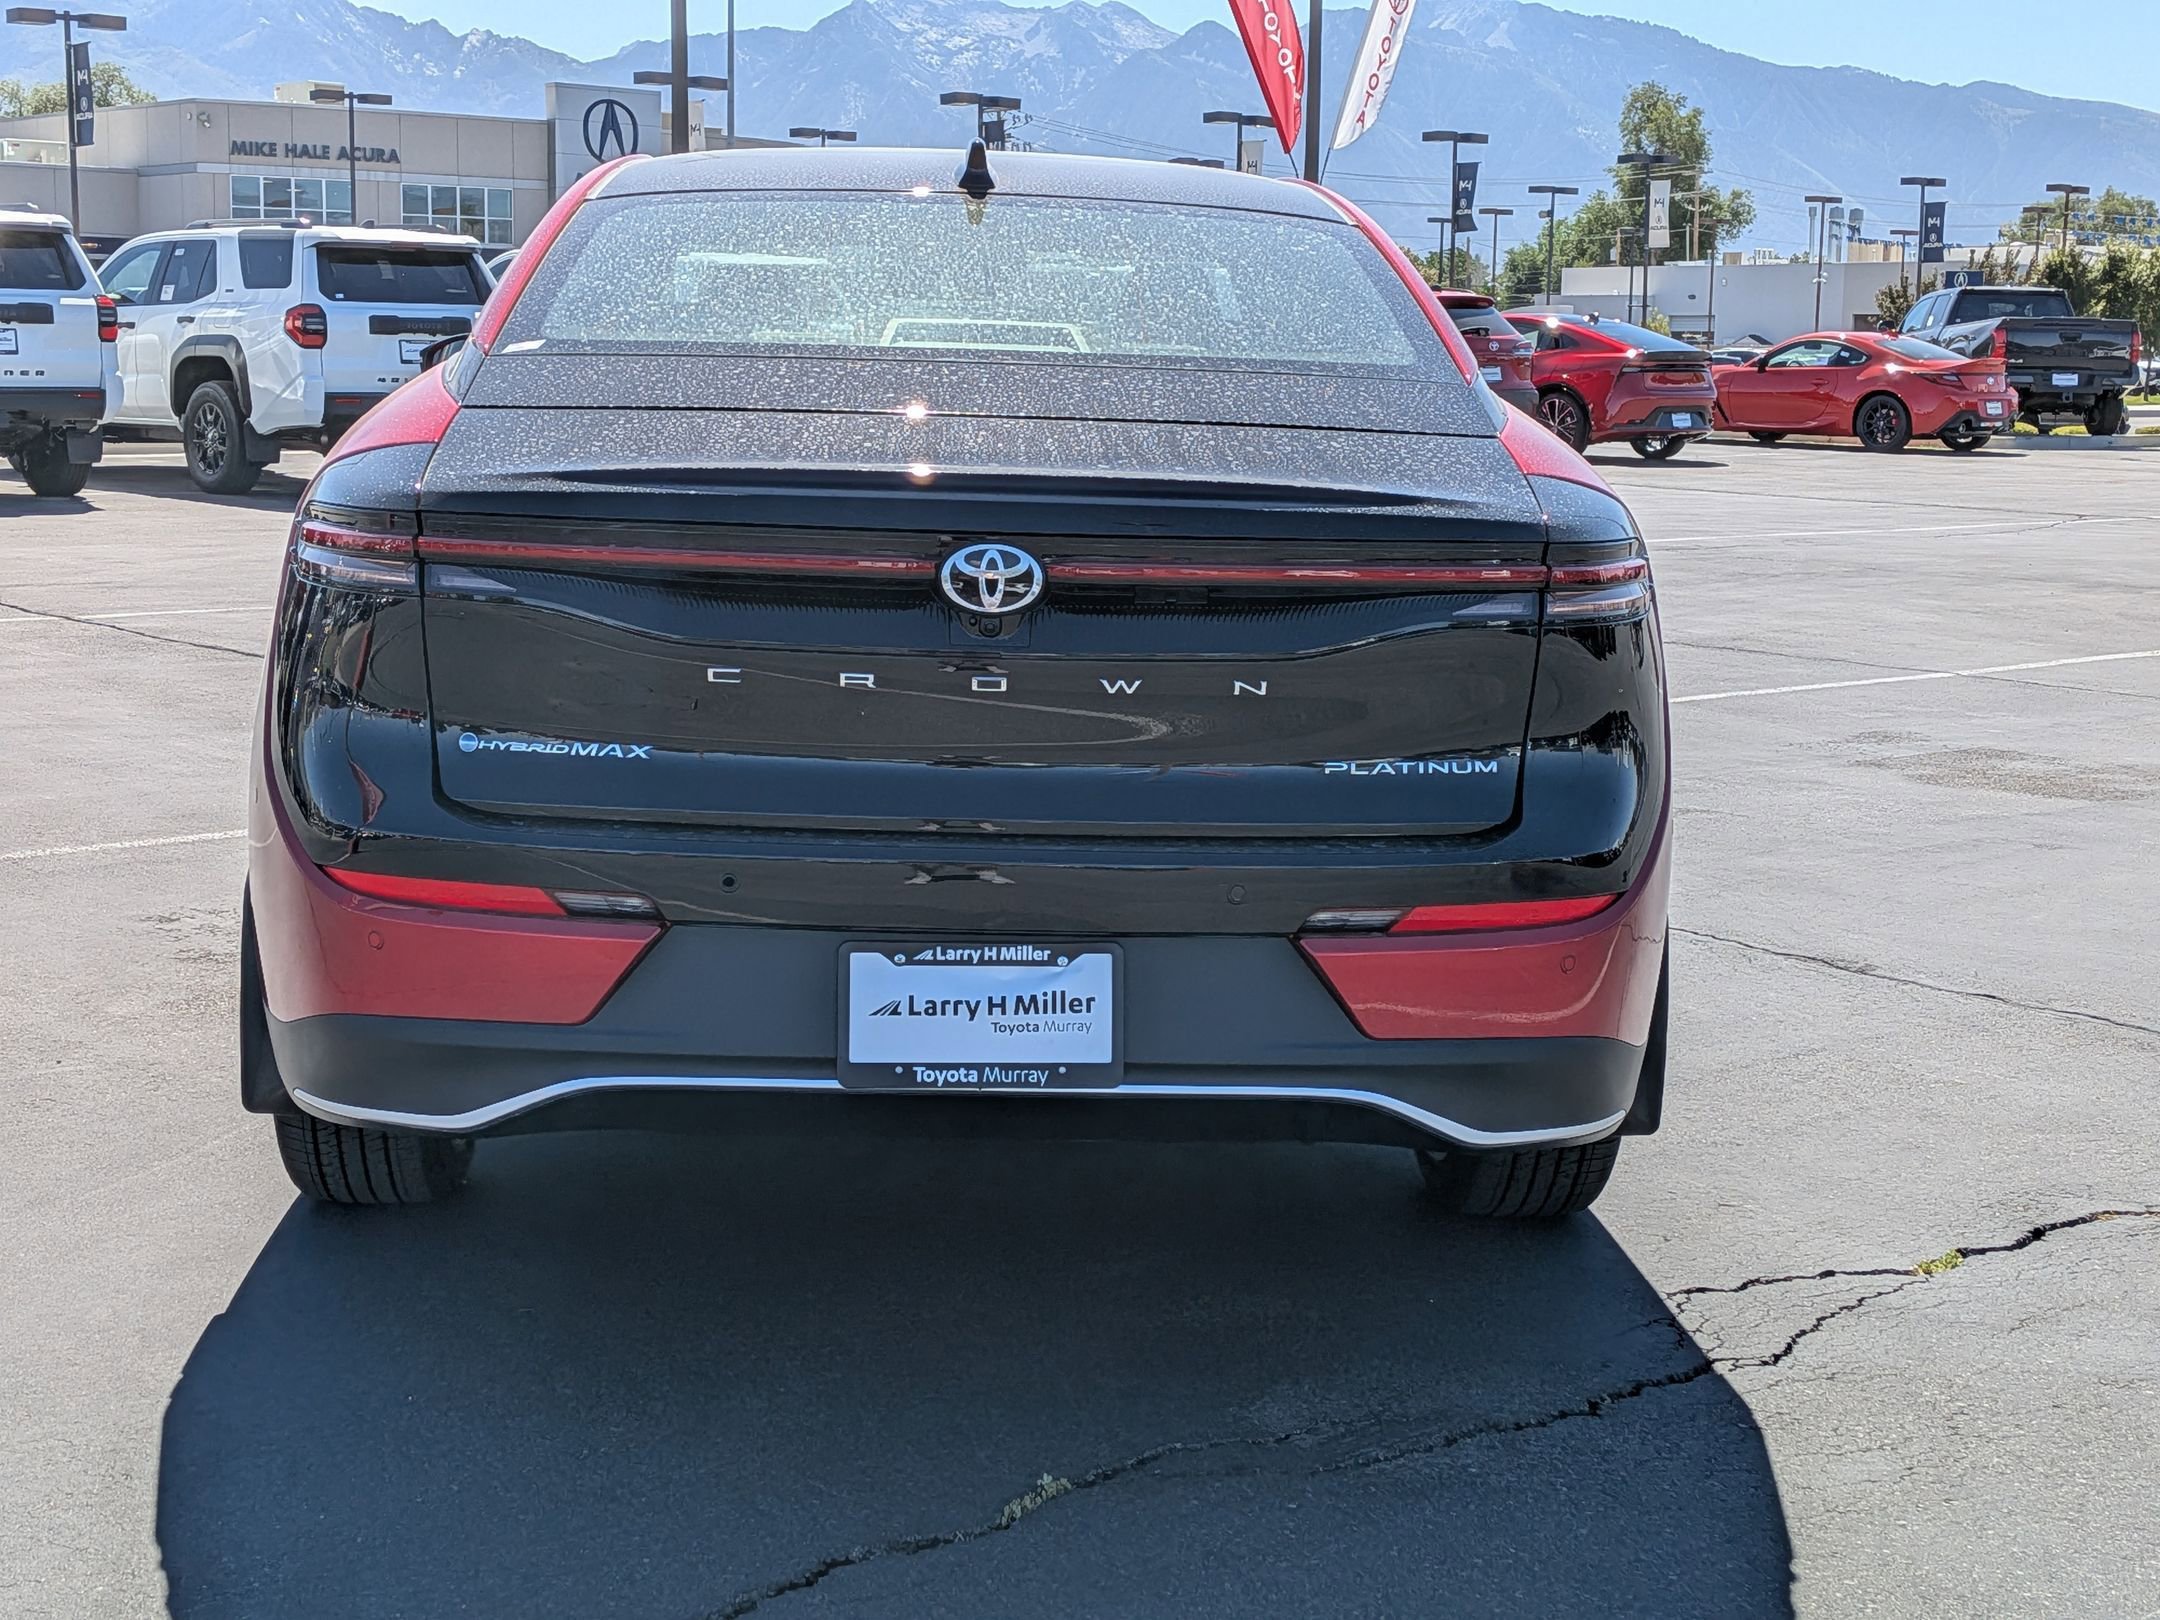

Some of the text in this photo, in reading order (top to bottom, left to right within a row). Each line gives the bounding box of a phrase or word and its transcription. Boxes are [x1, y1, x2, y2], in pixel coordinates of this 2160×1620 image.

[1356, 17, 1397, 129] TOYOTA
[231, 140, 401, 164] MIKE HALE ACURA
[707, 667, 1268, 695] CROWN
[1324, 760, 1498, 776] PLATINUM
[936, 945, 1052, 965] Larry H Miller
[908, 990, 1096, 1021] Larry H Miller
[991, 1019, 1093, 1037] Toyota Murray
[912, 1066, 1049, 1087] Toyota Murray
